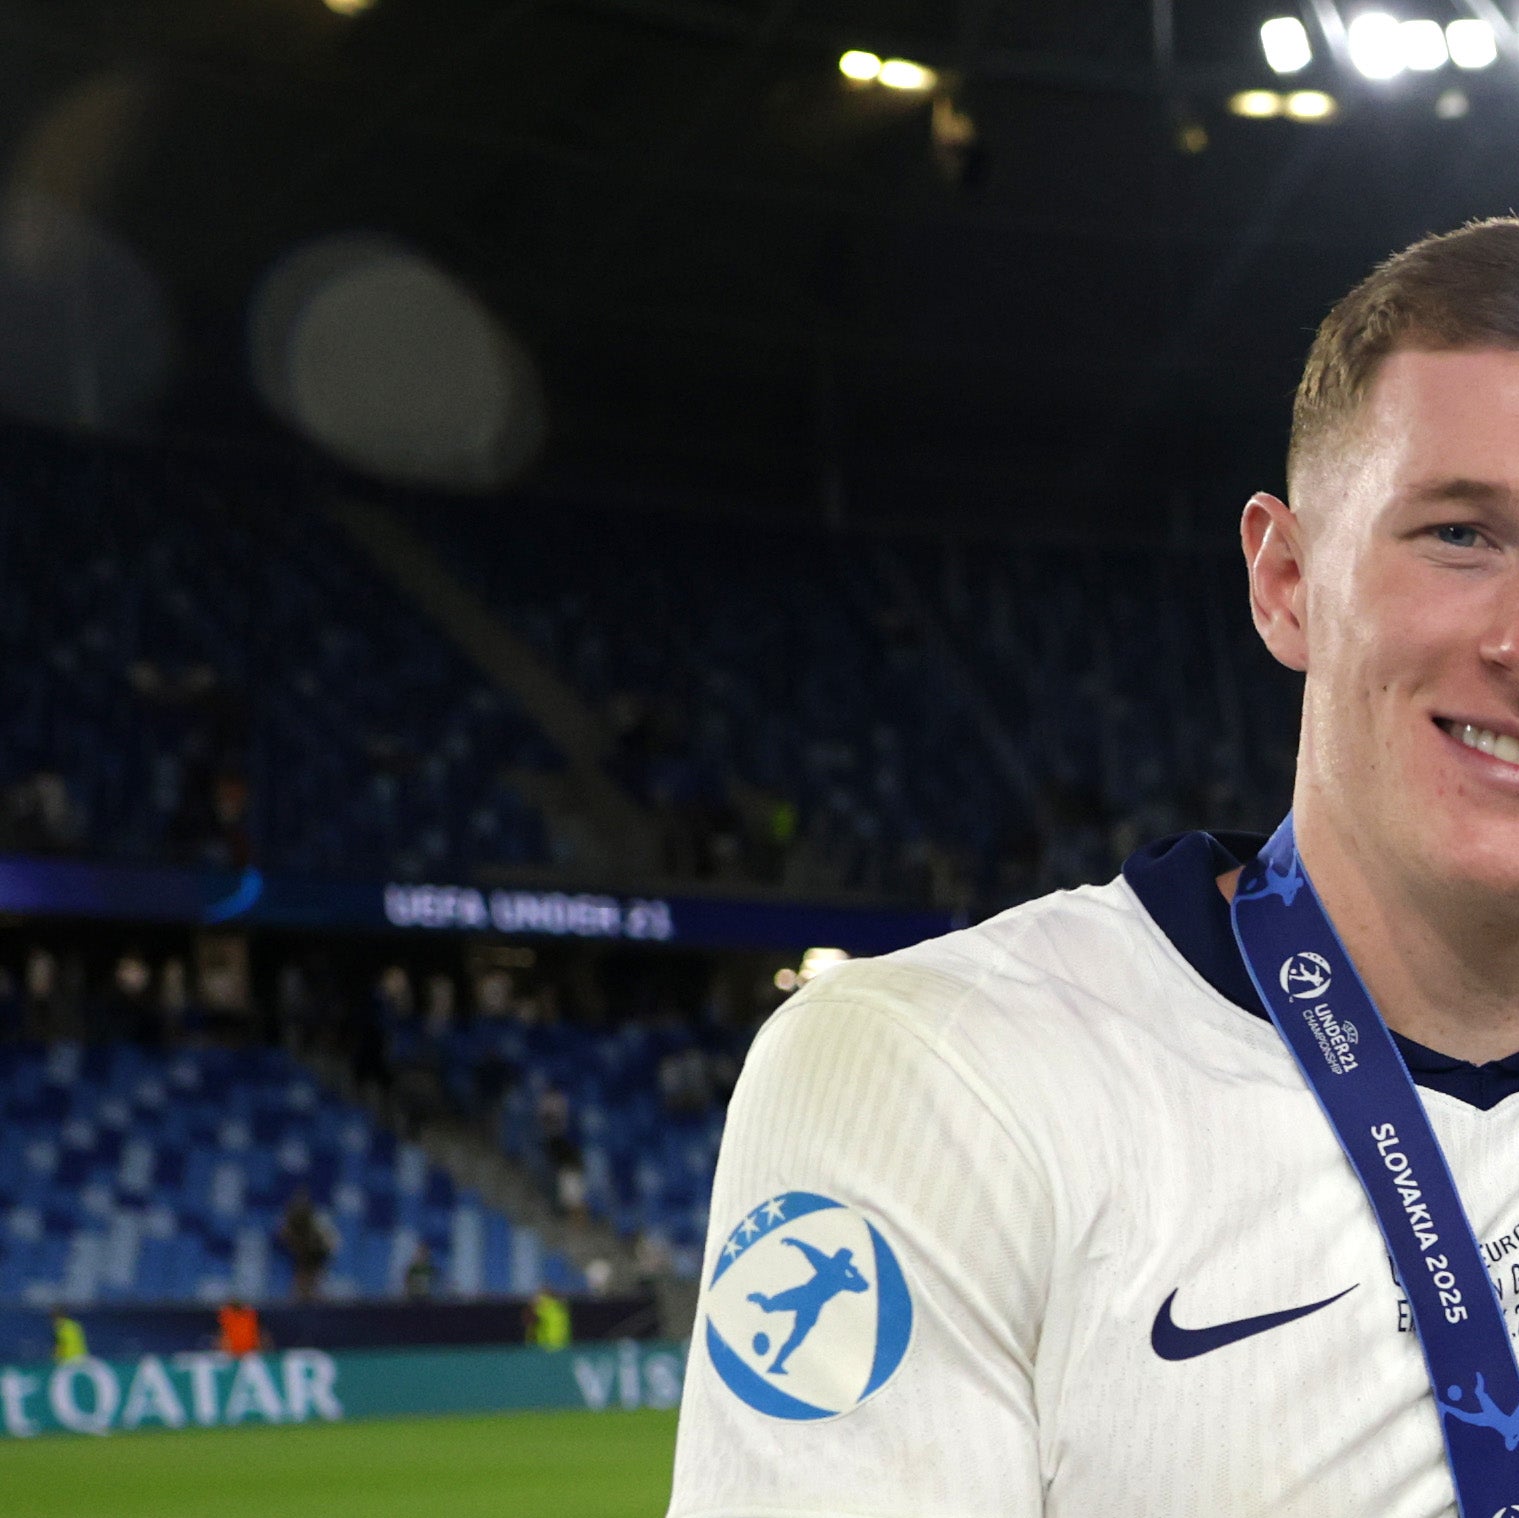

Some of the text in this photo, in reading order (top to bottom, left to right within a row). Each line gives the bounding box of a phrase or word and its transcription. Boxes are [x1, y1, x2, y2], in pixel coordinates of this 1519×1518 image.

[1302, 1009, 1344, 1075] CHAMPIONSHIP
[1314, 1003, 1359, 1073] UNDER21
[1371, 1122, 1469, 1324] SLOVAKIA 2025
[574, 1336, 690, 1411] vis
